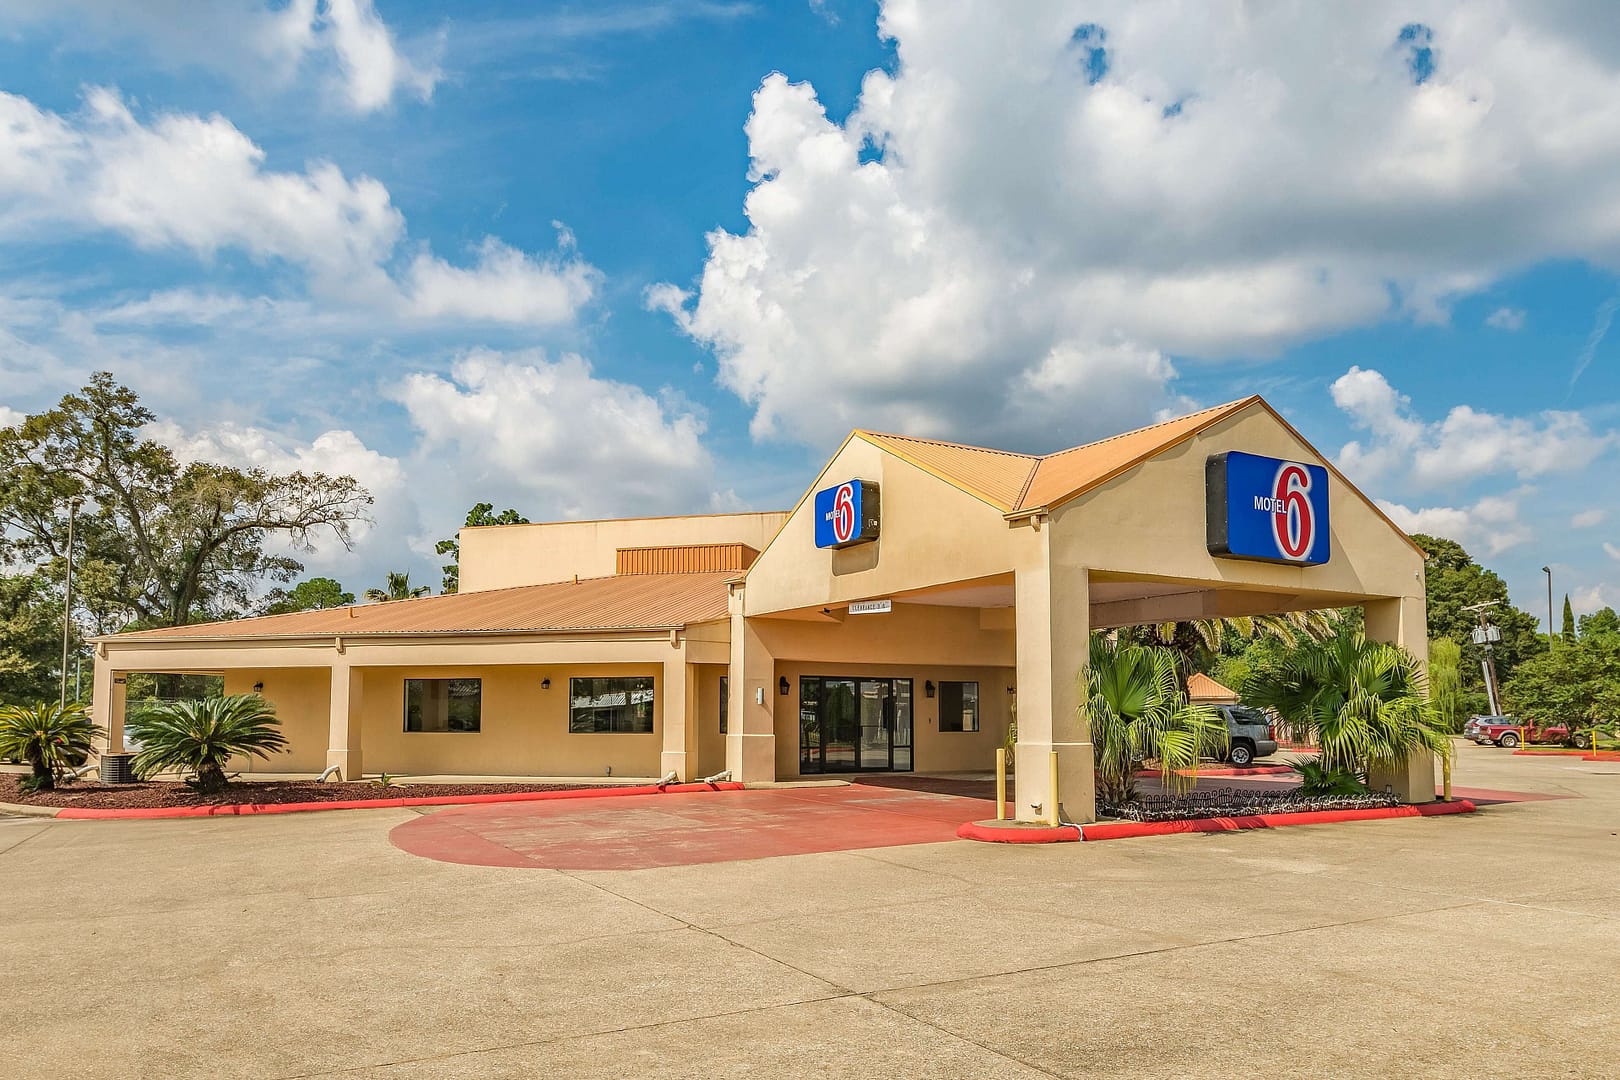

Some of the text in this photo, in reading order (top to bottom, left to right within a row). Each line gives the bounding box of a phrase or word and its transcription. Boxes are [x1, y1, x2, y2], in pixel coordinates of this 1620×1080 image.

[825, 484, 854, 542] MOTEL 6
[1254, 464, 1313, 559] MOTEL 6
